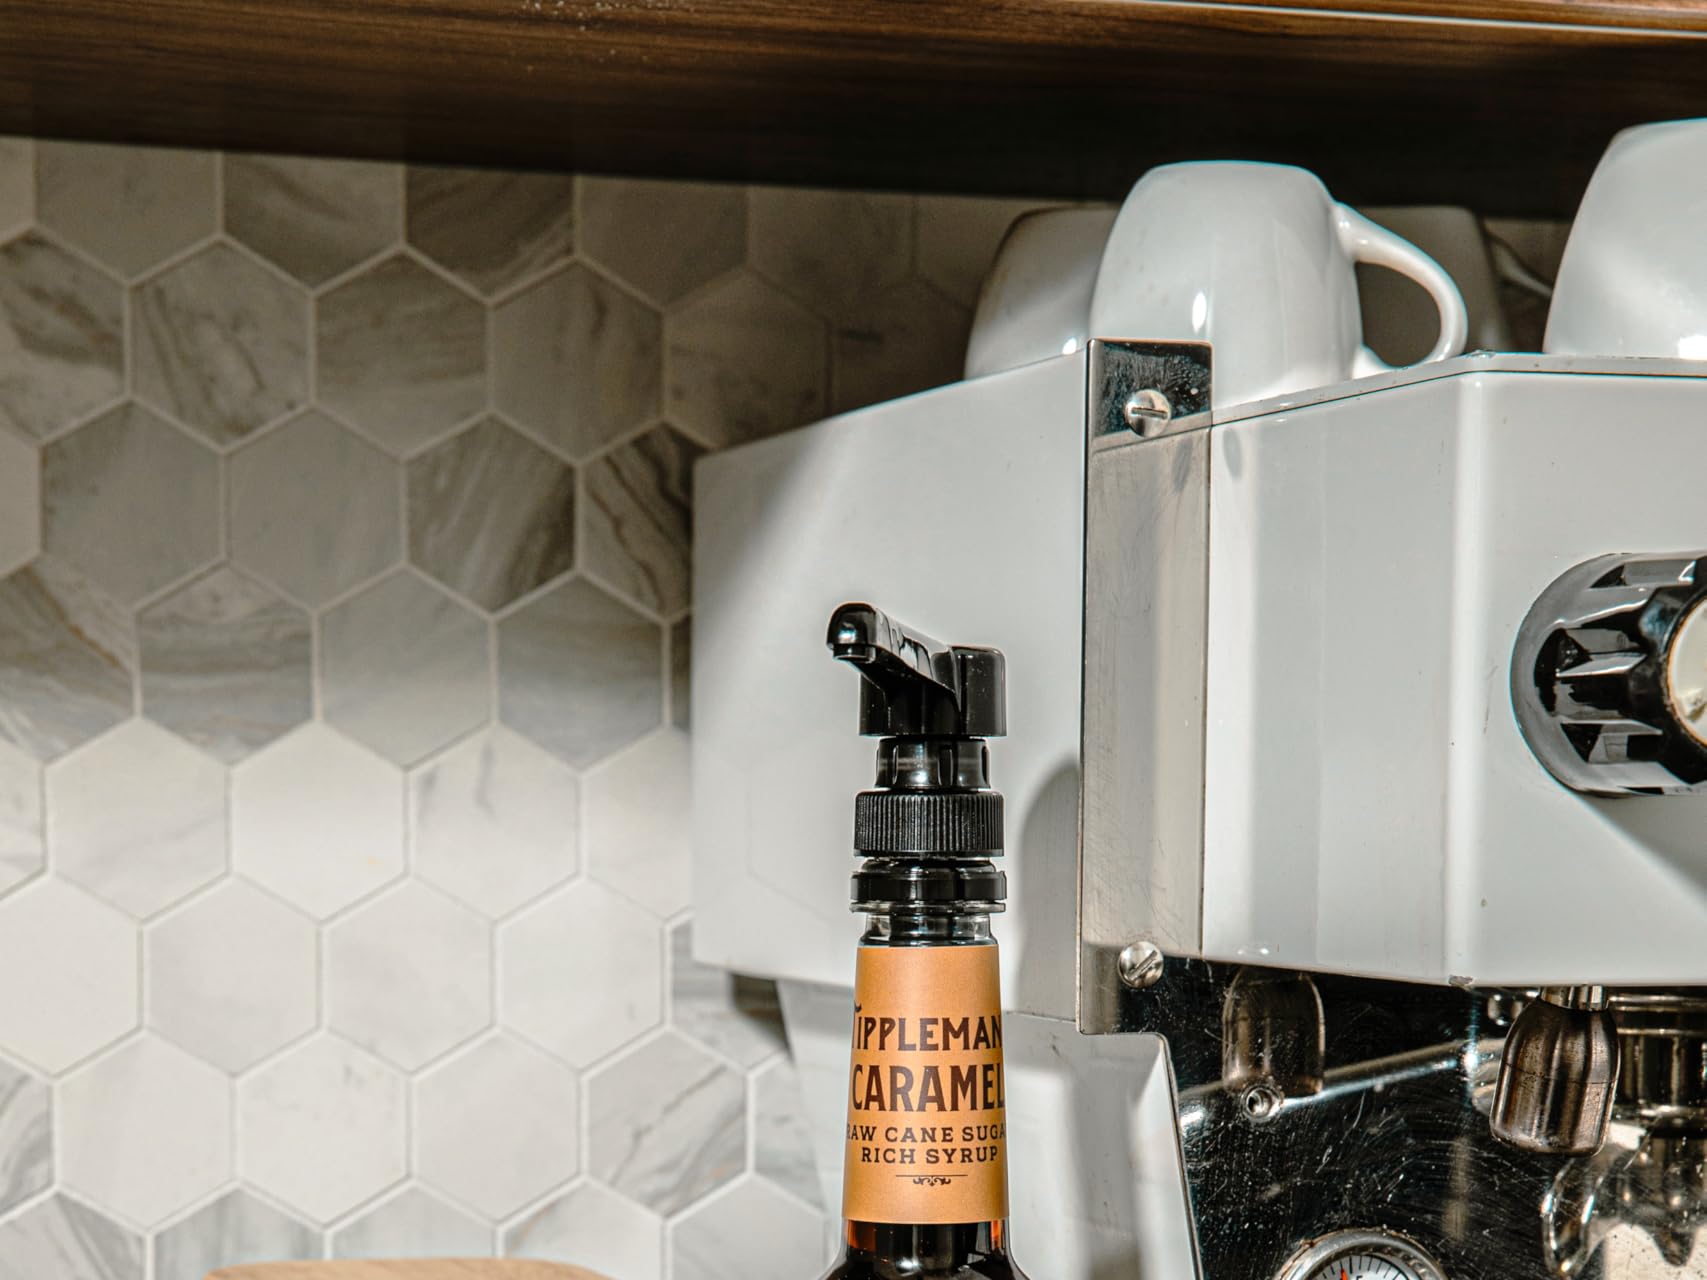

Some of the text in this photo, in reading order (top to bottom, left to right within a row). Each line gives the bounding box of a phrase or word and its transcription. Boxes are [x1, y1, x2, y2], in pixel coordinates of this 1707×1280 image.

[852, 1002, 1002, 1051] IPPLEMAN
[852, 1064, 1004, 1112] CARAMEL
[885, 1127, 953, 1143] CANE
[962, 1122, 1005, 1143] SUGA
[861, 1146, 998, 1164] RICH SYRUP
